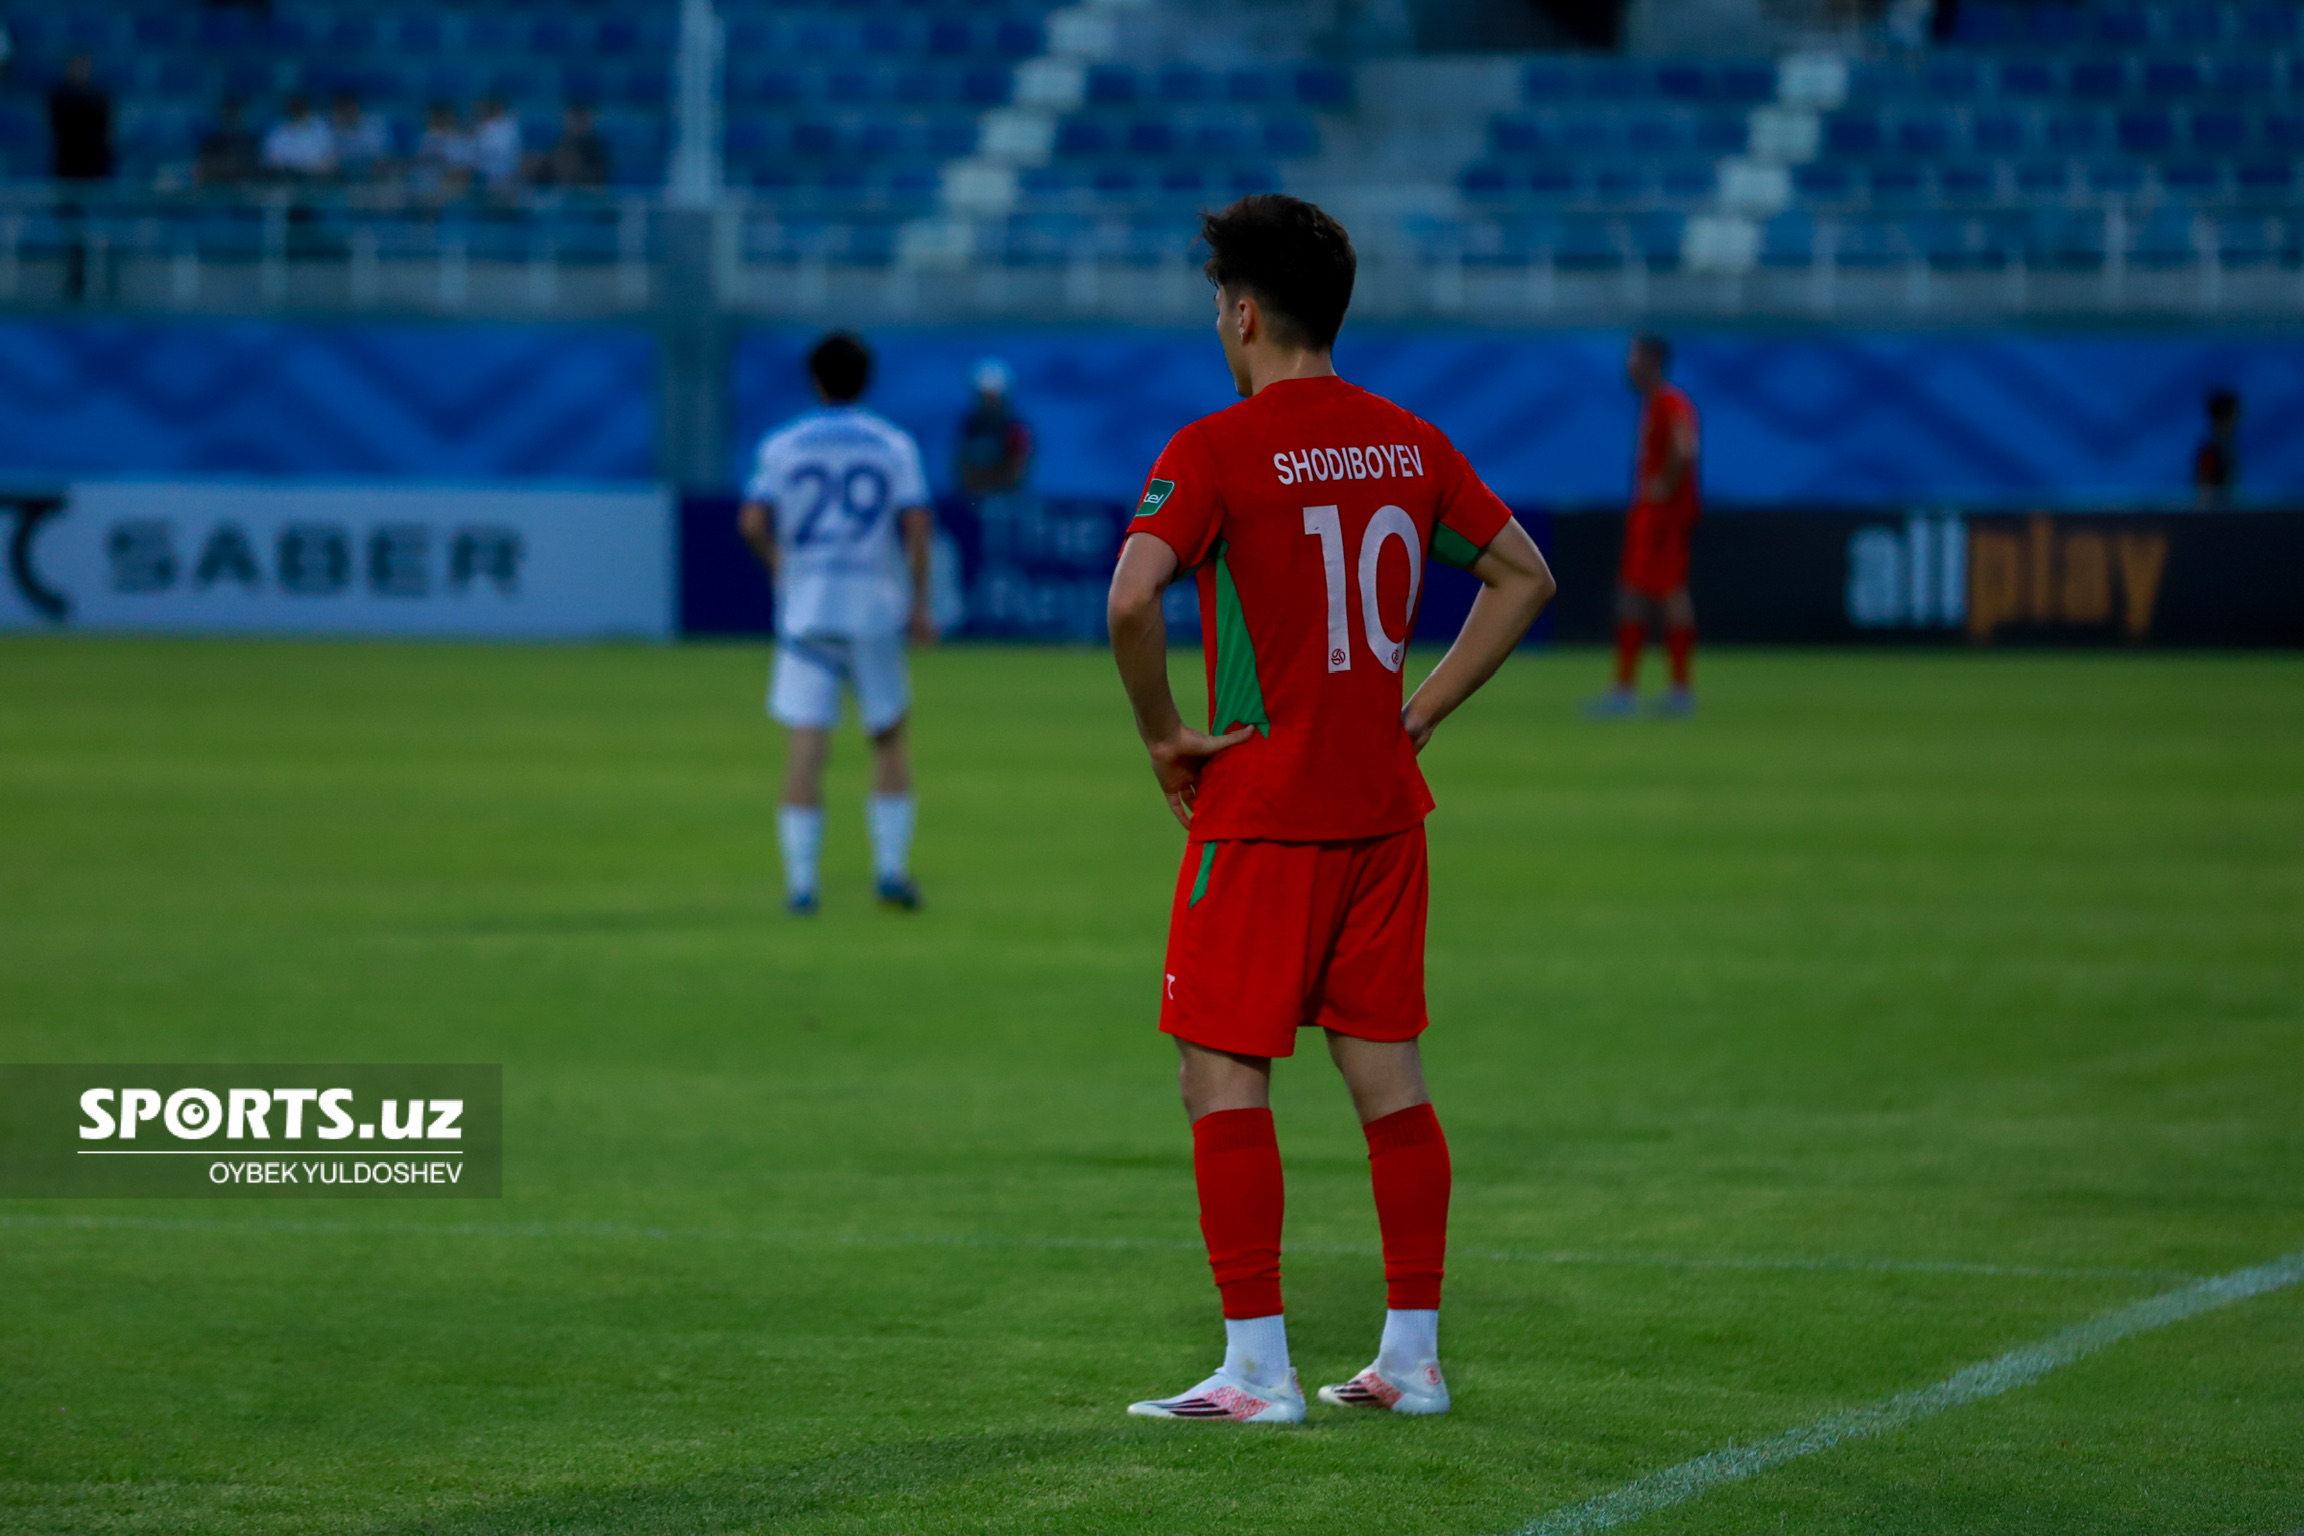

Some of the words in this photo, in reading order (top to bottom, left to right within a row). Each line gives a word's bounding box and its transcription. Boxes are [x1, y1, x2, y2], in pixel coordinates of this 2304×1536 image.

[788, 462, 890, 548] 29
[1273, 444, 1425, 486] SHODIBOYEV
[107, 518, 524, 598] SABER
[1303, 504, 1422, 673] 10
